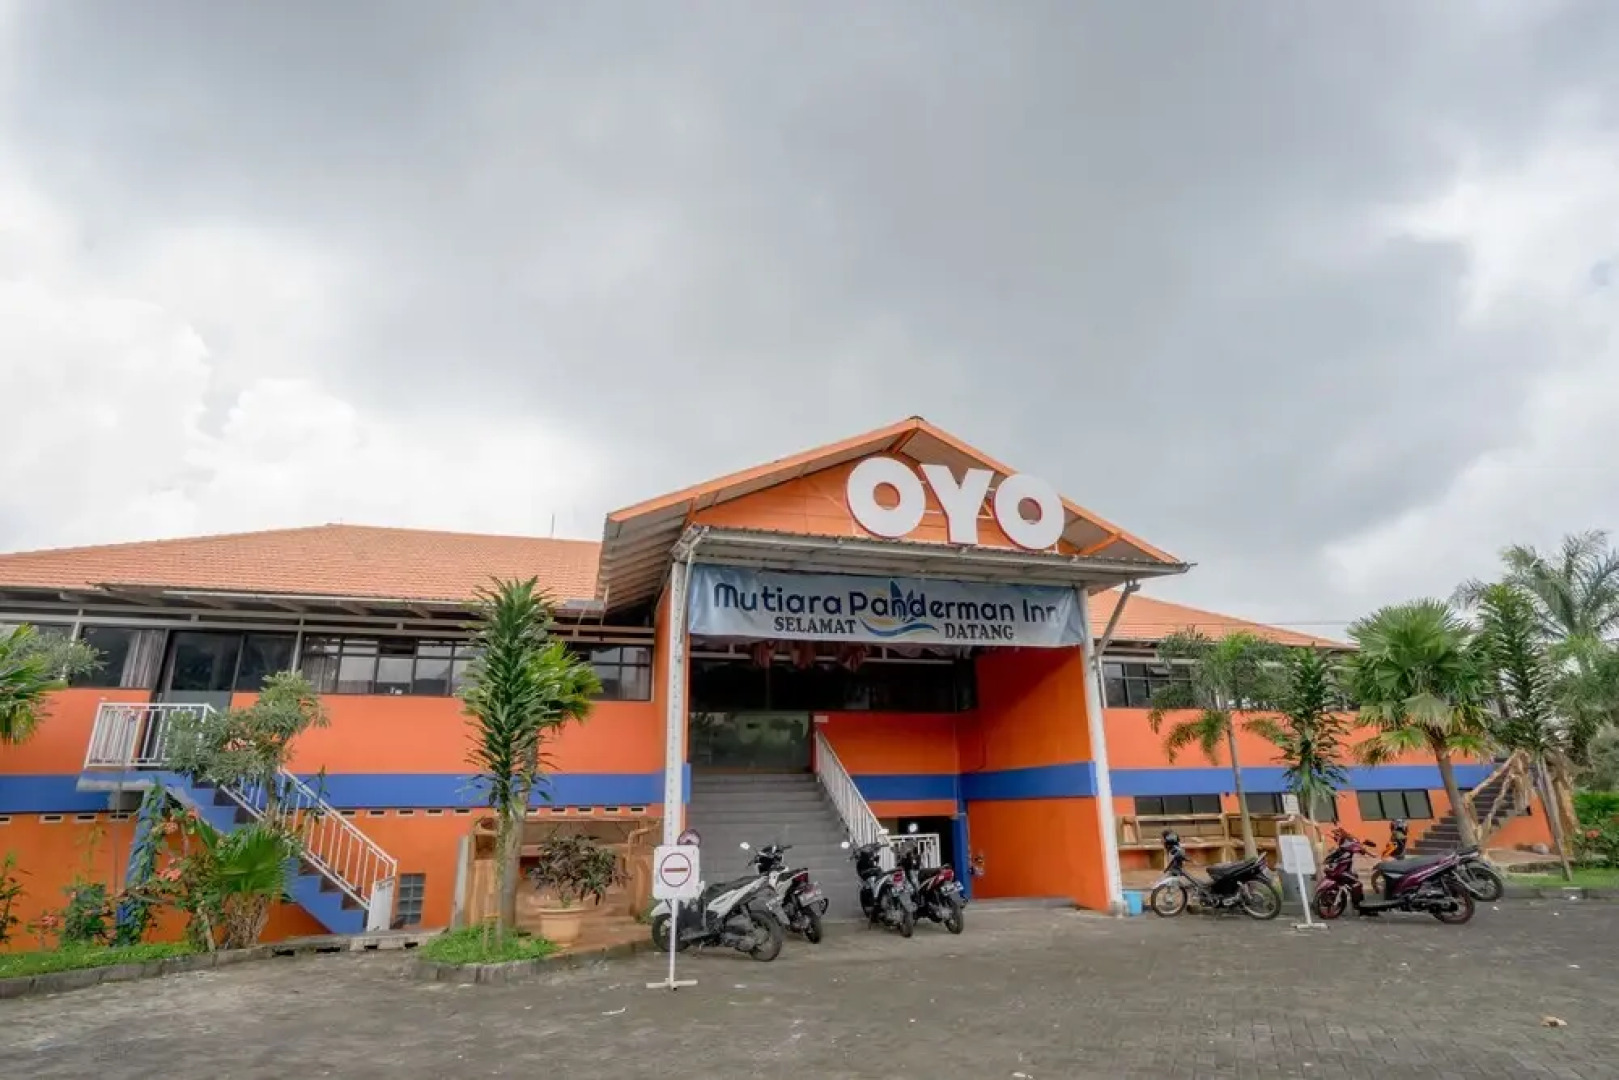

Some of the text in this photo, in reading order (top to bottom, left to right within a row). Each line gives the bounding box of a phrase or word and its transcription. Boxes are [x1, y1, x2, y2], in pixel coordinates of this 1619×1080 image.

[847, 457, 1064, 551] OYO
[713, 582, 842, 615] Mutiara
[848, 590, 1015, 622] Panderman
[774, 616, 1015, 640] SELAMAT DATANG
